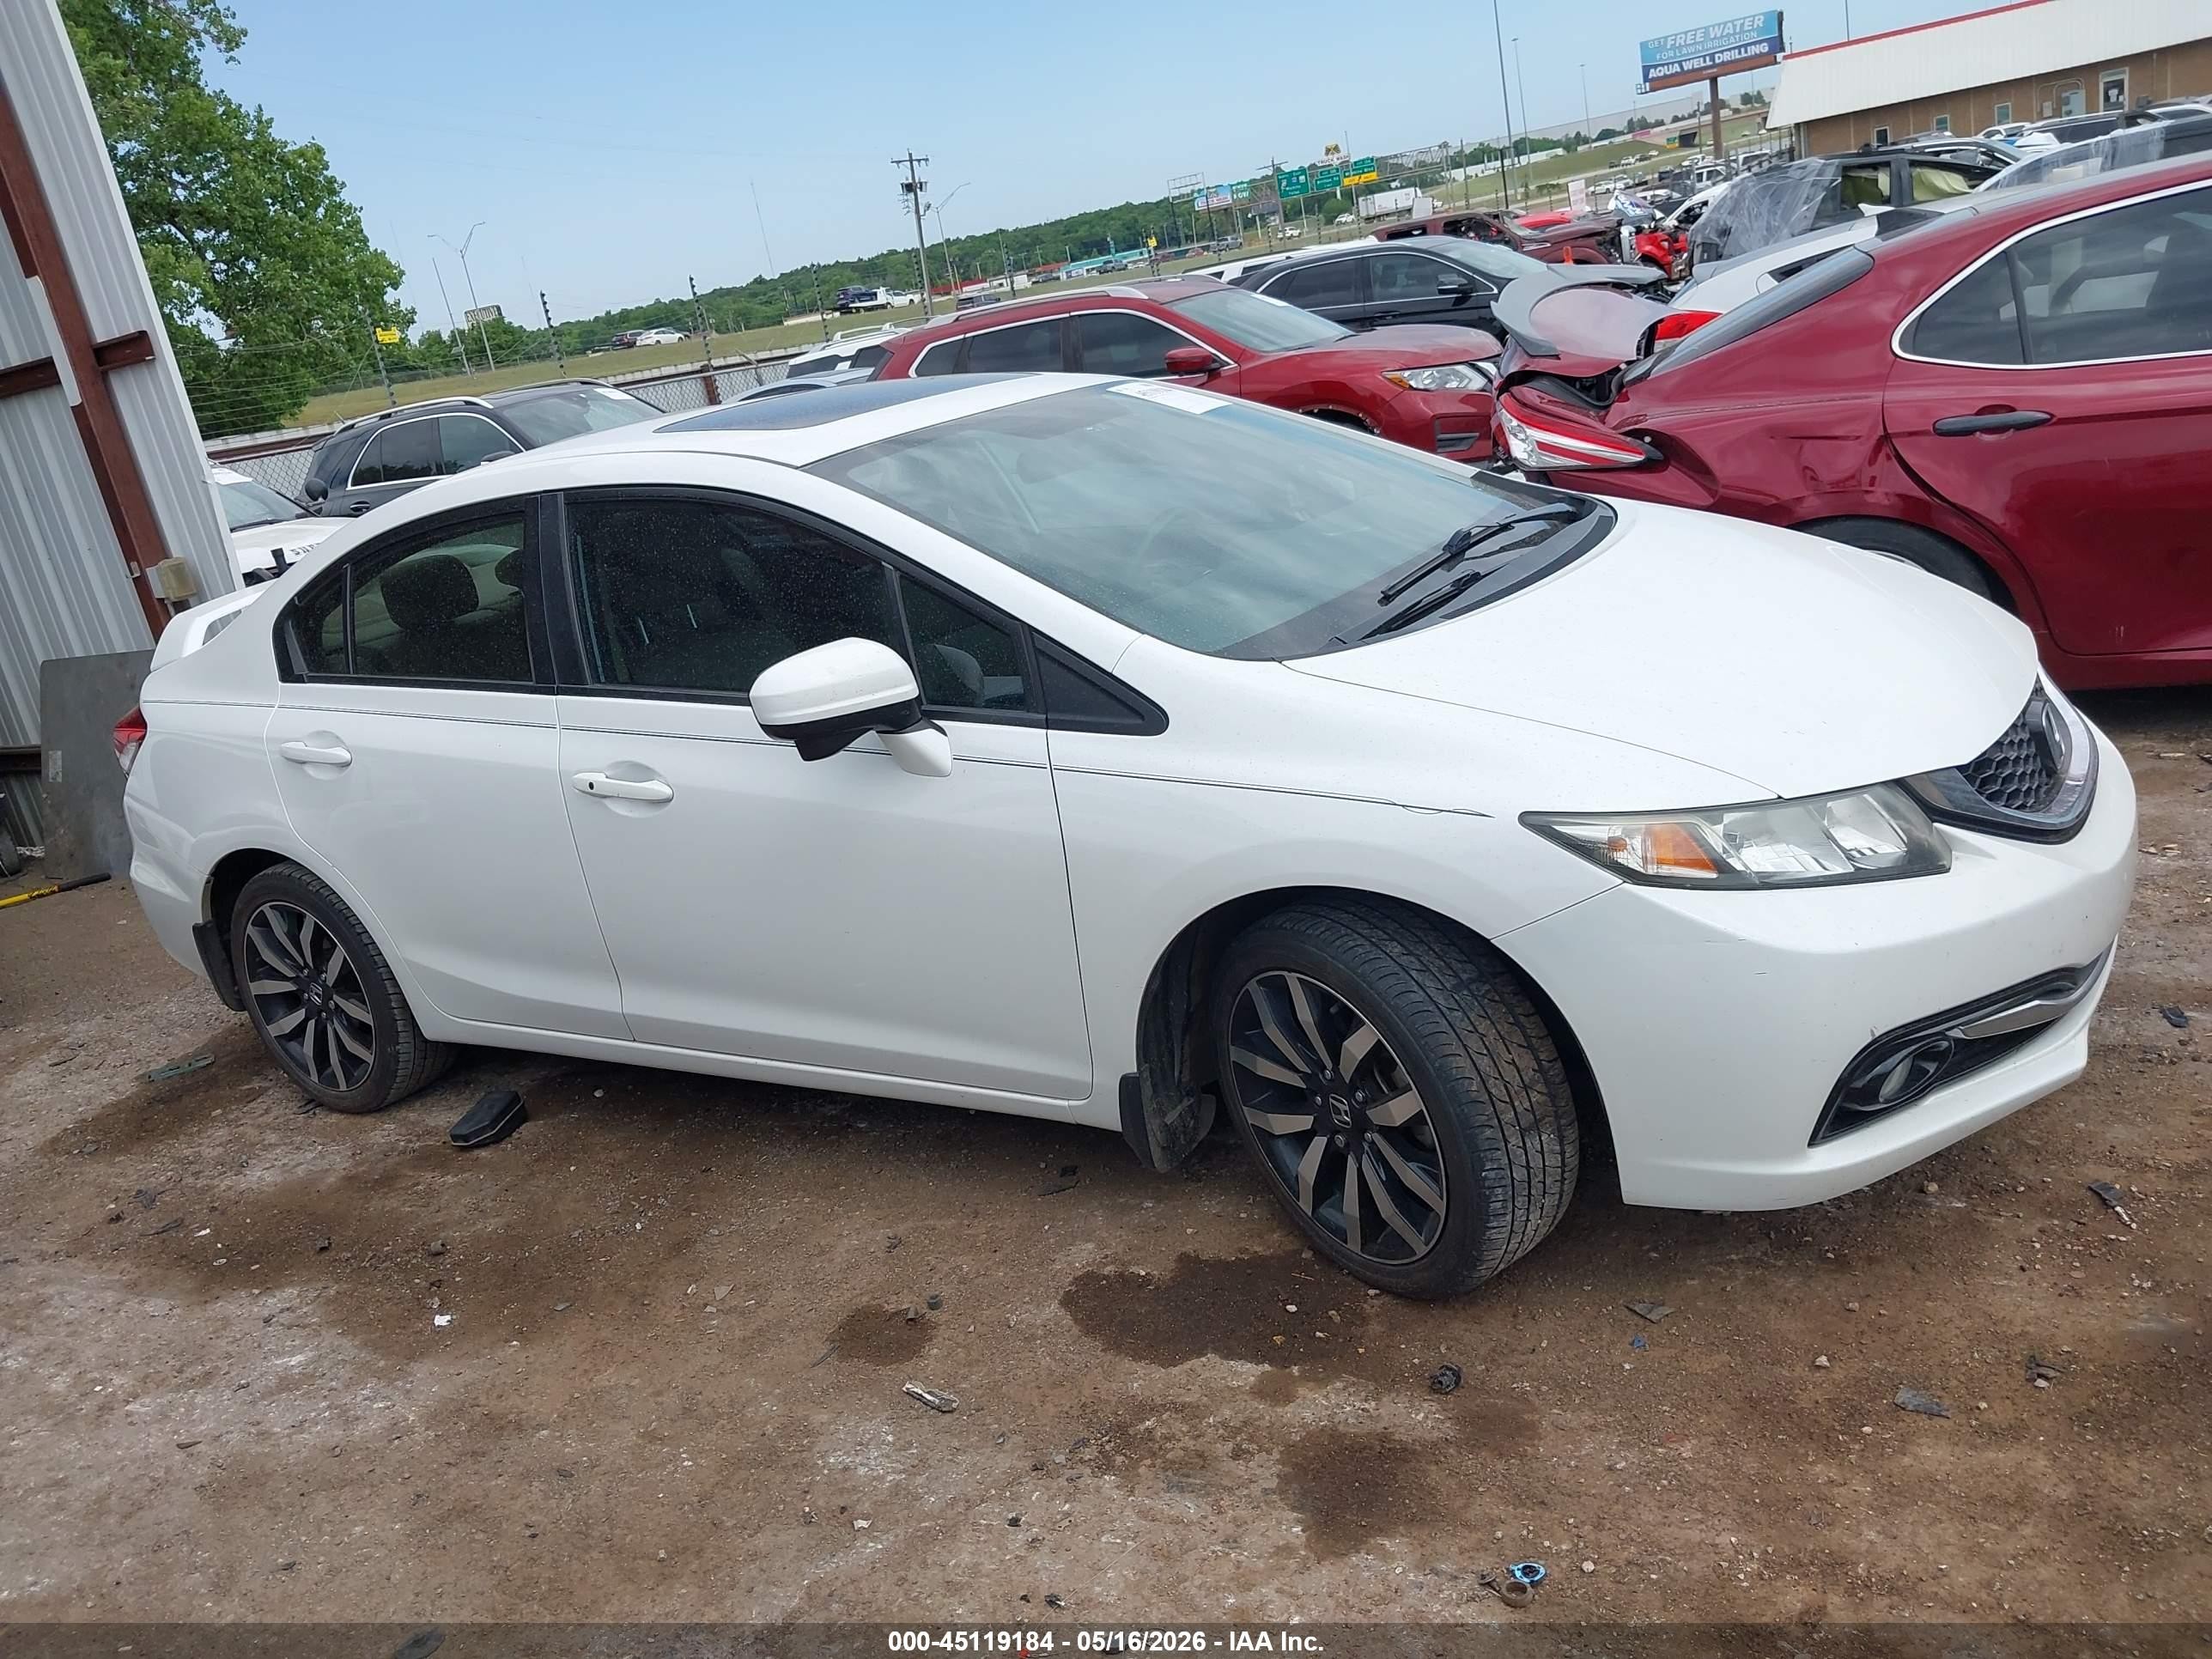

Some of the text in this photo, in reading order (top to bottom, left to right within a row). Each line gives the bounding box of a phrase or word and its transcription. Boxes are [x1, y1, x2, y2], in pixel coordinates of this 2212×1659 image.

[1649, 15, 1765, 49] GET FREE WATER
[1656, 31, 1758, 61] FOR LAWN IRRIGATION
[1649, 42, 1769, 79] AQUA WELL DRILLING
